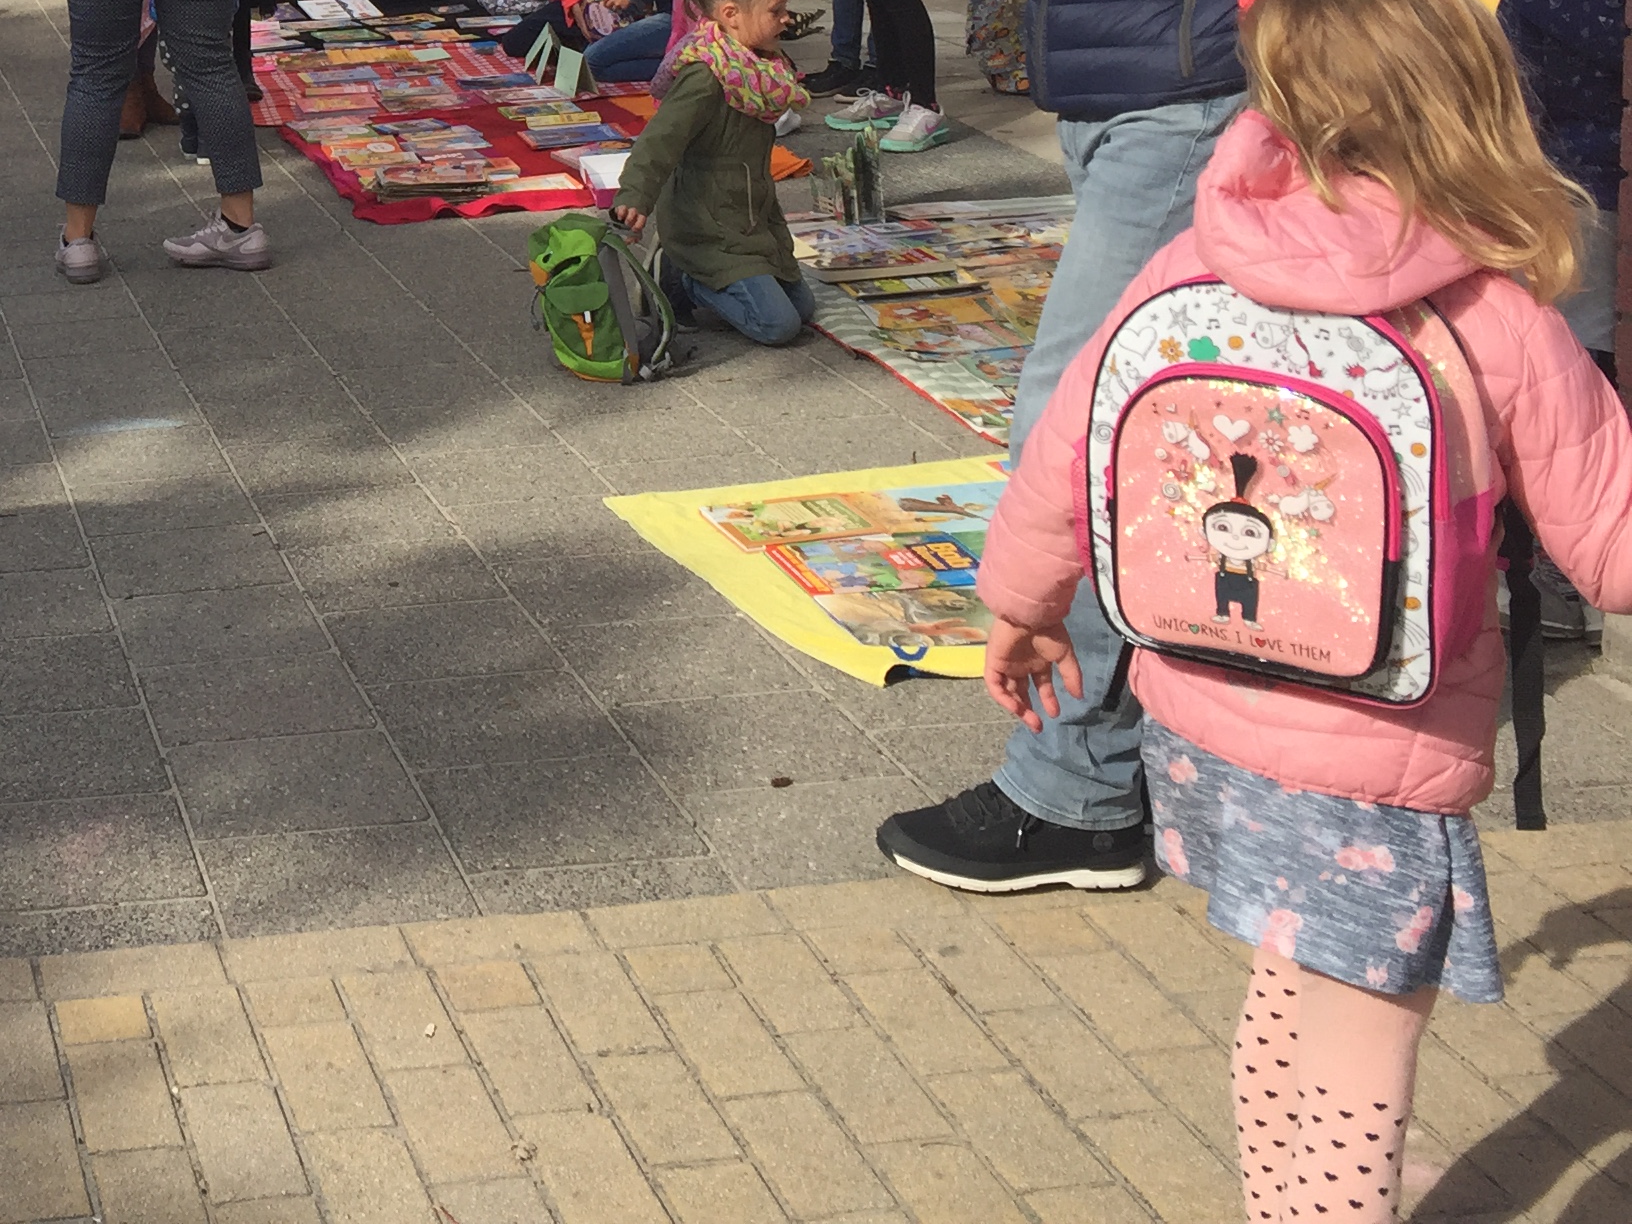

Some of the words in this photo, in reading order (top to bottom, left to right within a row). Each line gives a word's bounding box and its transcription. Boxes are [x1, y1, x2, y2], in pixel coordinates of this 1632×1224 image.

[1235, 630, 1243, 645] I
[1249, 634, 1285, 653] LOVE
[1290, 643, 1332, 664] THEM
